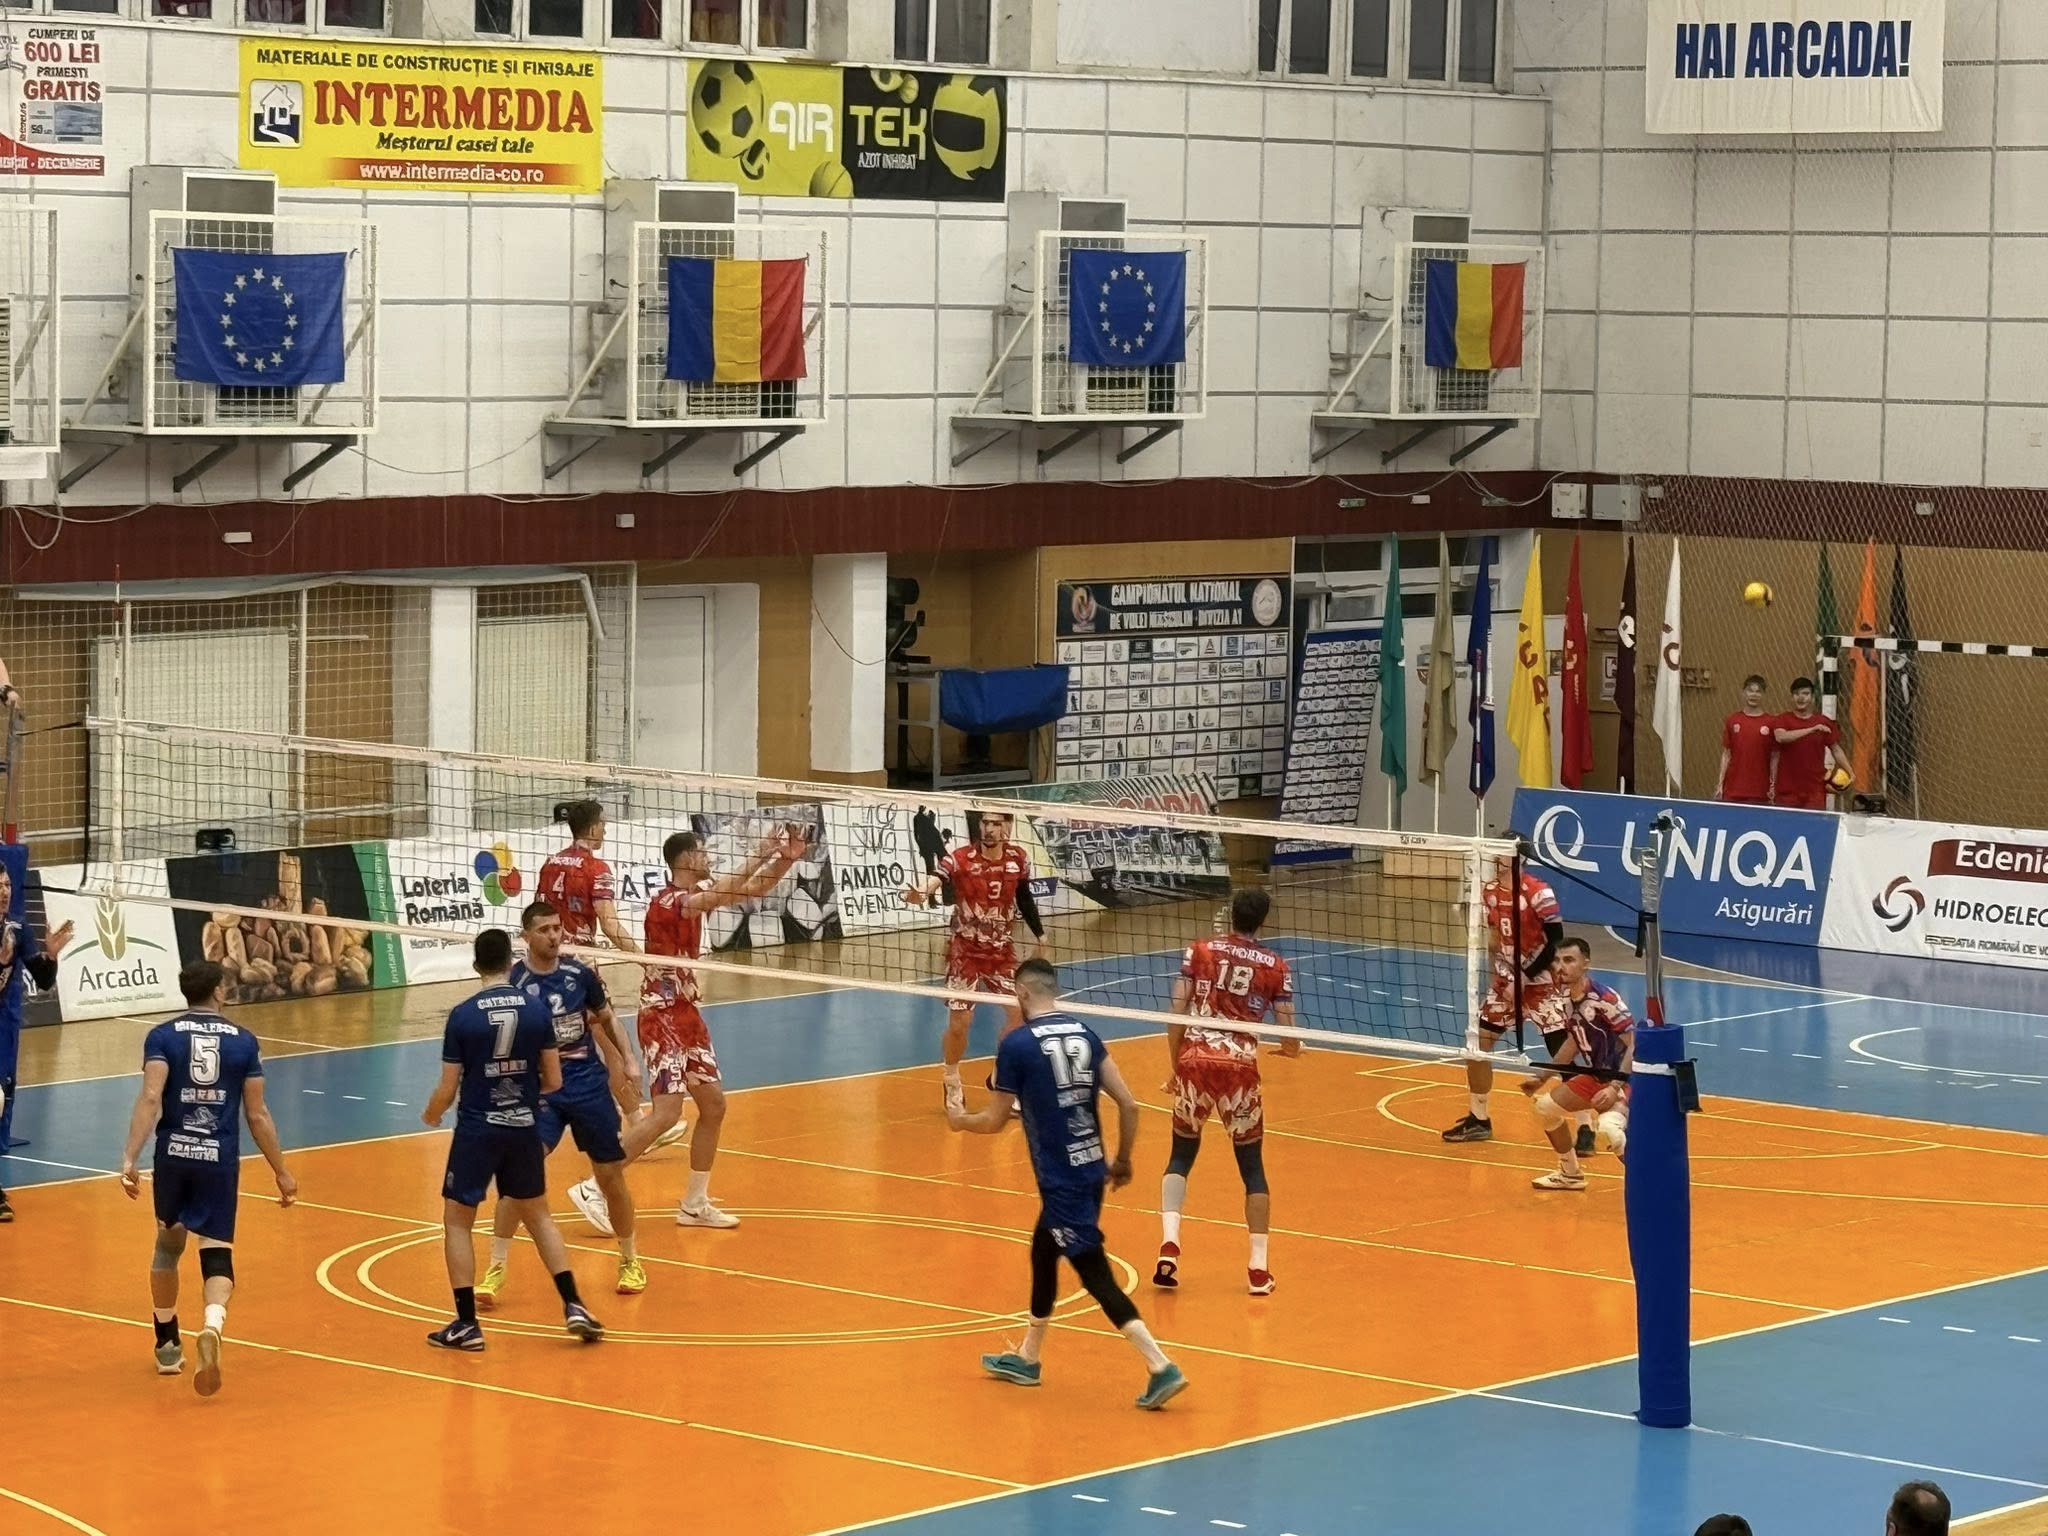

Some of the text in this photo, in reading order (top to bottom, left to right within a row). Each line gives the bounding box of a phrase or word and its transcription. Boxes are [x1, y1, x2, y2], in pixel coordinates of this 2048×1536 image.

[28, 28, 96, 40] CUMPERI DE
[24, 41, 62, 63] 600
[68, 42, 100, 64] LEI
[257, 49, 351, 68] MATERIALE
[356, 55, 379, 69] DE
[523, 61, 595, 77] FINISAJE
[1675, 20, 1912, 79] HAI ARCADA!
[23, 79, 101, 102] GRATIS
[313, 80, 594, 134] INTERMEDIA
[456, 136, 497, 153] casei
[501, 136, 535, 154] tale
[768, 101, 928, 161] AIR TEK
[358, 162, 545, 183] www.intermedia-co.ro
[858, 151, 881, 169] AZOT
[1620, 820, 1816, 892] UNIQA
[401, 872, 470, 898] Loteria
[552, 871, 566, 893] 4
[841, 861, 904, 892] AMIRO
[987, 880, 1002, 900] 3
[1714, 896, 1813, 927] Asigurări
[1500, 917, 1513, 937] 8
[78, 958, 160, 992] Arcada
[487, 1008, 519, 1059] 7
[190, 1034, 221, 1086] 5
[1039, 1034, 1094, 1089] 12
